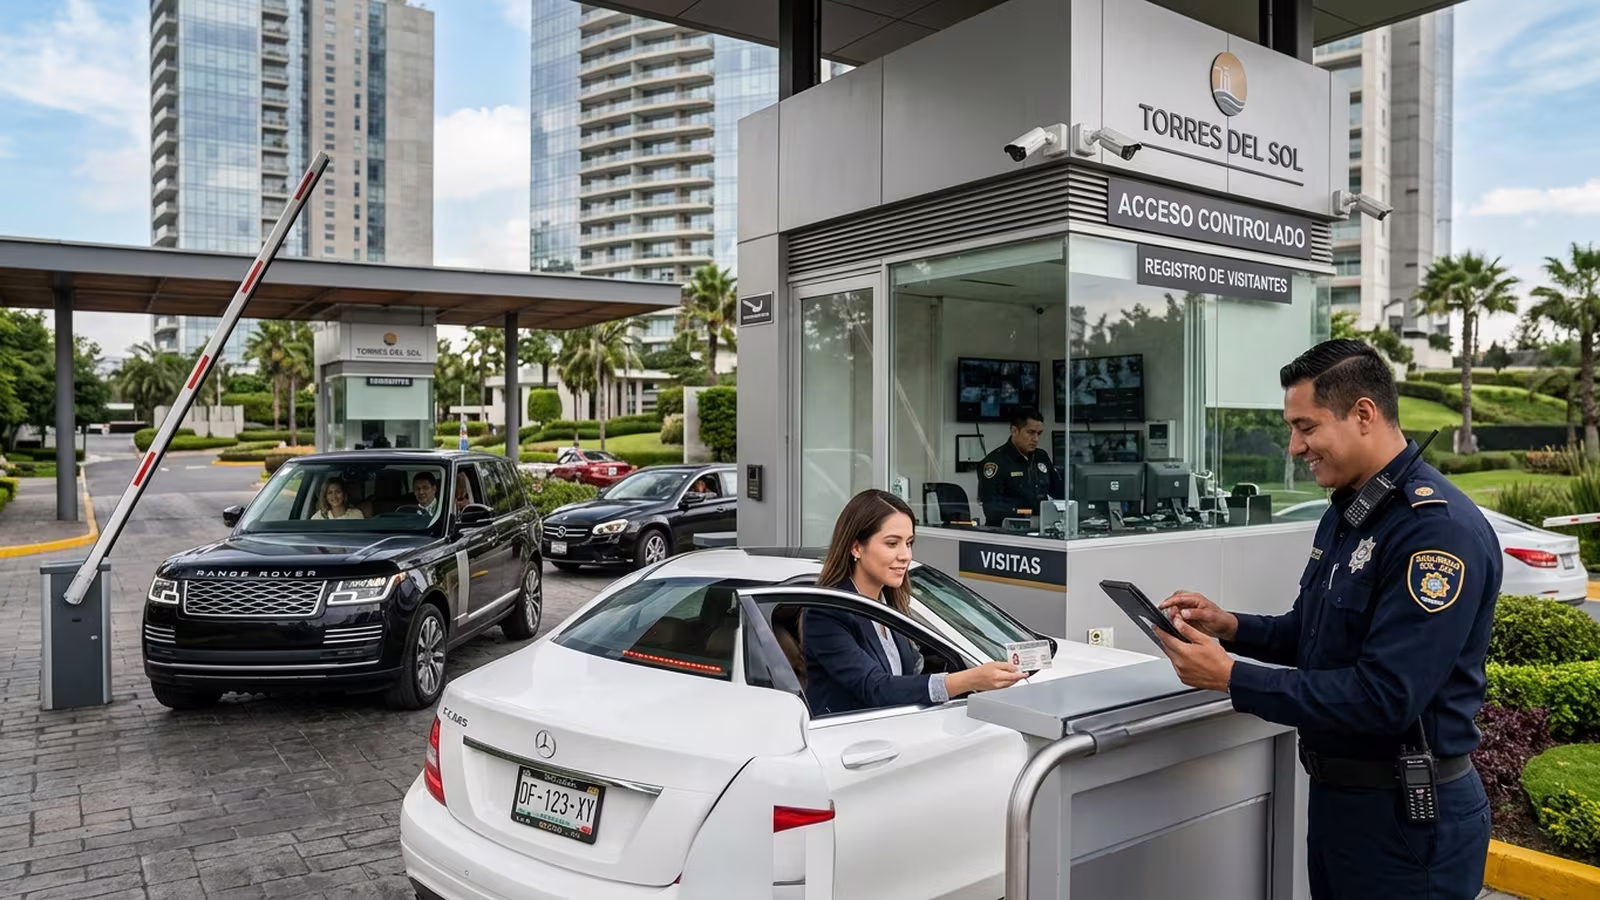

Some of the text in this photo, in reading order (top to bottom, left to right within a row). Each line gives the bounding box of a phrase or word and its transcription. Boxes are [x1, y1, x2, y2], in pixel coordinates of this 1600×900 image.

[1138, 103, 1304, 173] TORRES DEL SOL
[1117, 192, 1306, 249] ACCESO CONTROLADO
[1144, 257, 1288, 293] REGISTRO DE VISITANTES
[259, 569, 316, 578] ROVER
[980, 550, 1041, 575] VISITAS
[519, 781, 595, 822] DF-123-XY
